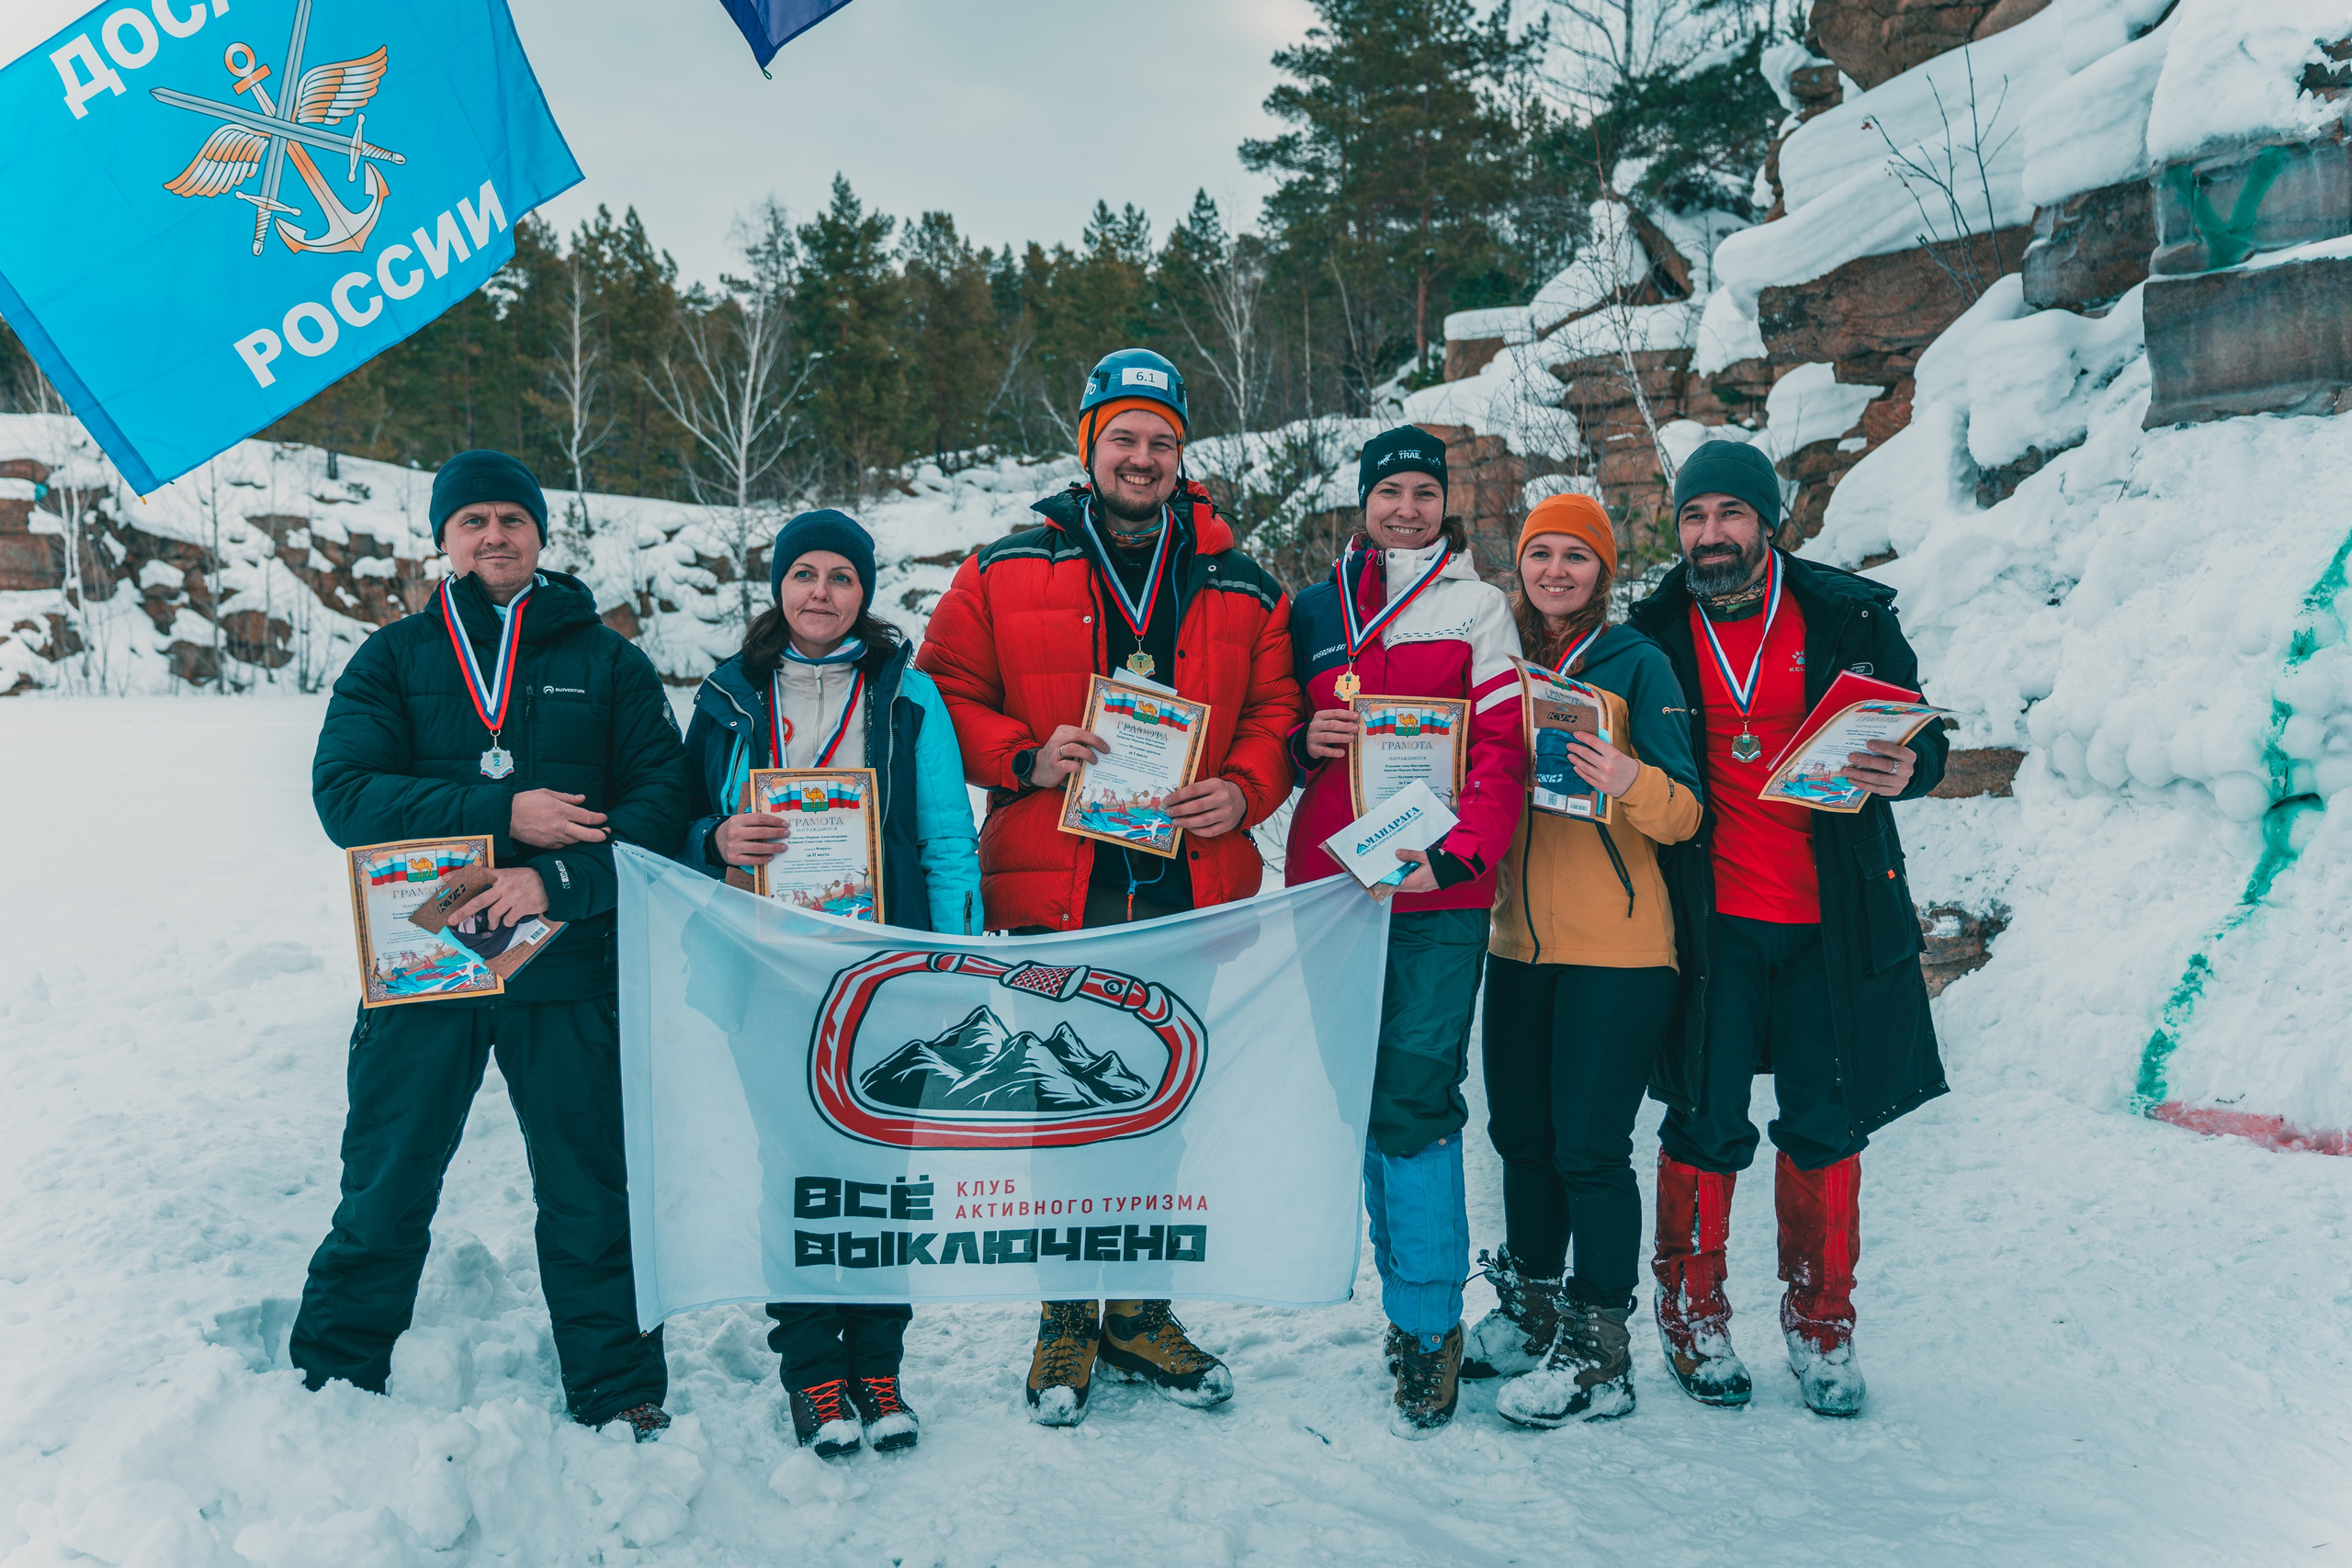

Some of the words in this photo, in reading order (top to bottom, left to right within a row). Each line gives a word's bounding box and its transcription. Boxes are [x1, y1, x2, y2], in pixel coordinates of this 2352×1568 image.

[49, 0, 230, 120] ДОС
[233, 179, 508, 389] РОССИИ
[1136, 371, 1155, 383] 6.1
[1547, 712, 1577, 724] KV+
[1382, 741, 1432, 750] ГРАМОТА
[493, 758, 501, 767] 2
[1536, 773, 1563, 783] KV+
[788, 817, 843, 827] ГРАМОТА
[1365, 807, 1420, 846] МАНАРАГА
[393, 886, 443, 898] ГРАМО
[437, 884, 466, 914] KV+
[956, 1179, 1016, 1197] КЛУБ
[794, 1174, 934, 1221] ВСЁ
[956, 1199, 1094, 1220] АКТИВНОГО
[1102, 1194, 1209, 1213] ТУРИЗМА
[794, 1224, 1207, 1269] ВЫКЛЮЧЕНО
